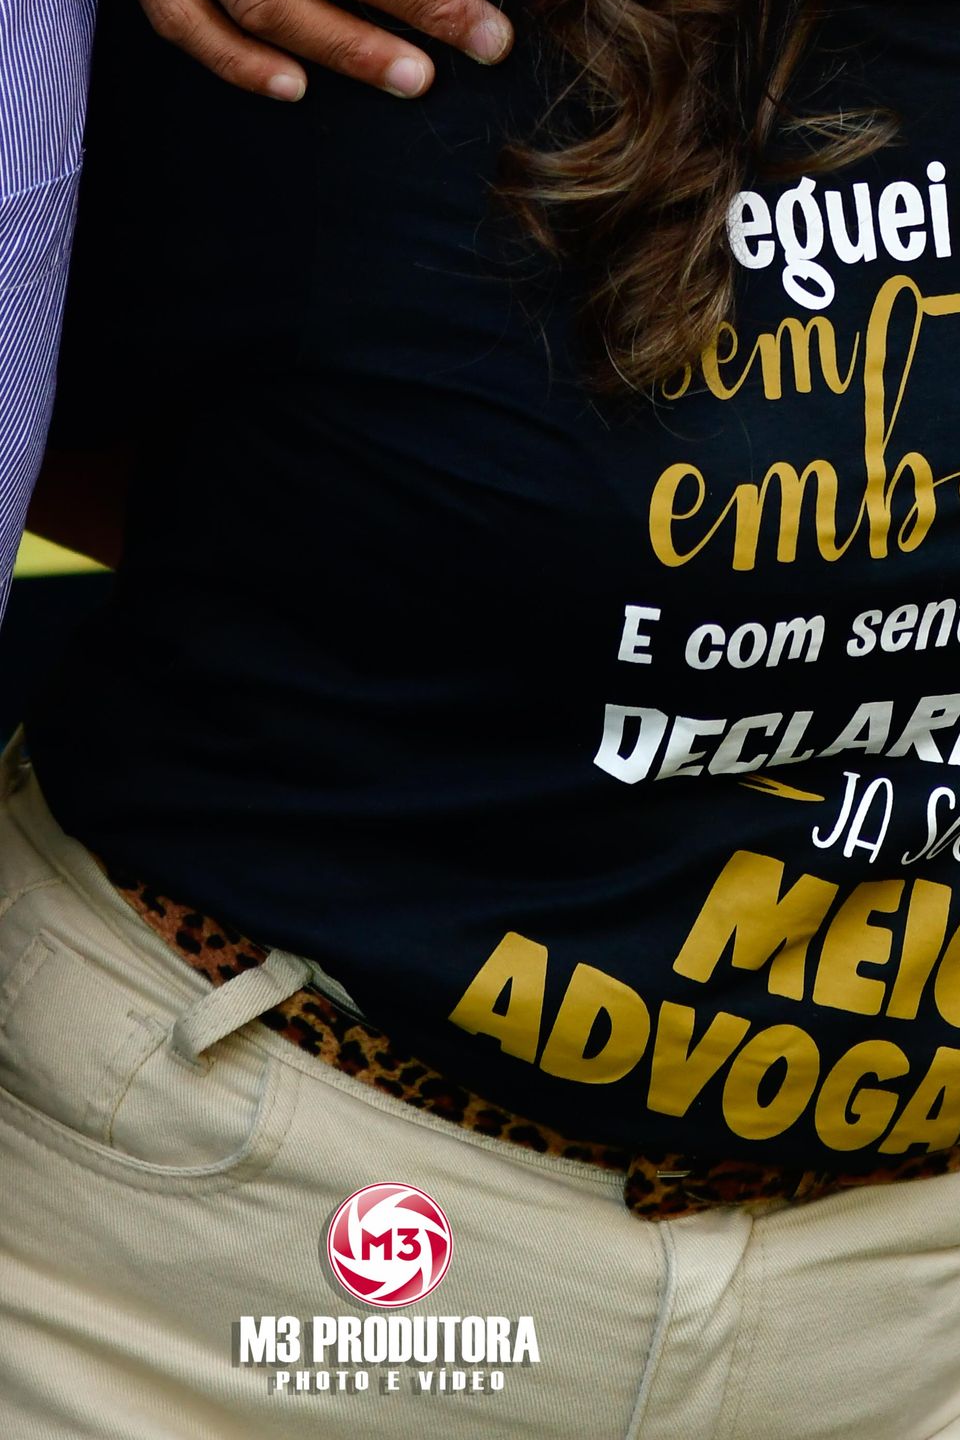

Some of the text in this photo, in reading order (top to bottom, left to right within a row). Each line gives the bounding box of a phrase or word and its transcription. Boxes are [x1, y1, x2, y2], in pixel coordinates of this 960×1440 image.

[726, 160, 948, 310] eguei
[617, 604, 661, 665] E
[684, 614, 825, 670] com
[812, 771, 894, 864] JA
